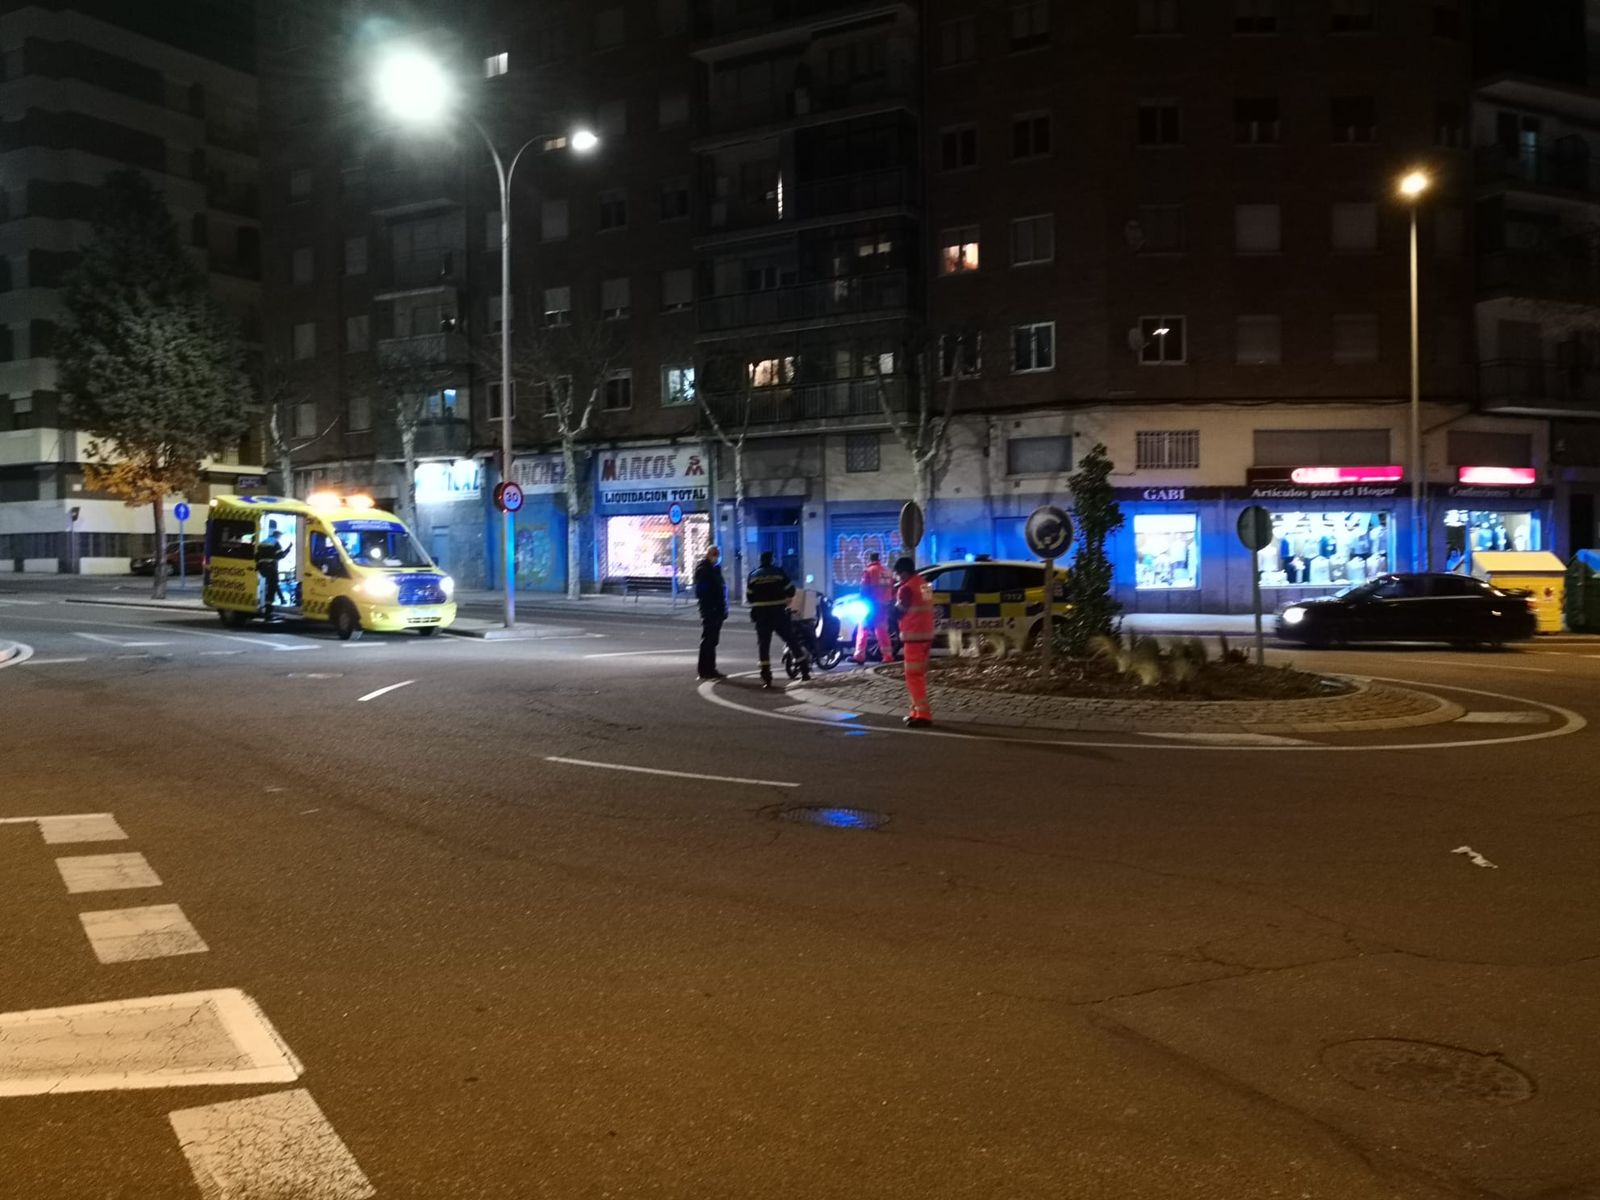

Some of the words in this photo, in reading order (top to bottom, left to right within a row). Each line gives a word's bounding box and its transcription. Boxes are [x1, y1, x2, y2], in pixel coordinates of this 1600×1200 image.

[601, 455, 677, 481] MARCOS
[505, 492, 519, 503] 30
[605, 490, 668, 503] LIQUIDACION
[671, 488, 706, 501] TOTAL
[1143, 488, 1185, 500] GABI
[1310, 488, 1340, 499] para
[1342, 487, 1355, 496] el
[1357, 486, 1398, 498] Hogar
[975, 618, 1004, 630] Local
